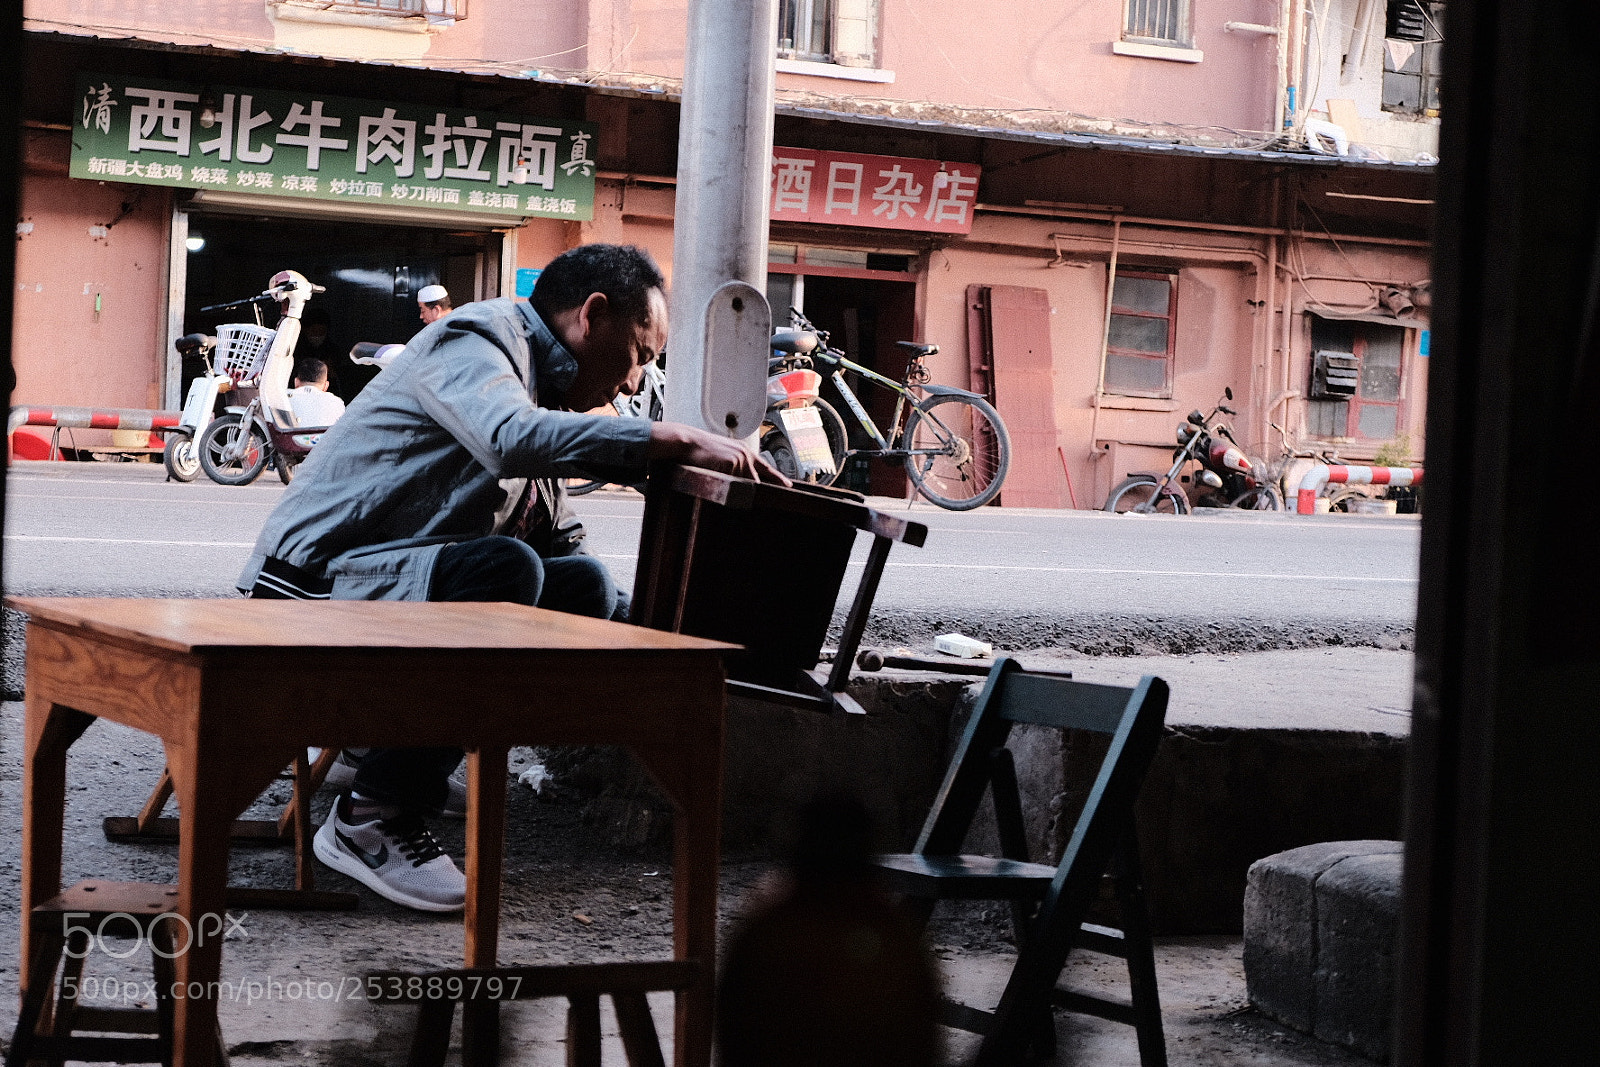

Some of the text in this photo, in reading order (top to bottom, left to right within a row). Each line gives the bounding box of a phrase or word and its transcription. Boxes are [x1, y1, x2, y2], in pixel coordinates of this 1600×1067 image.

[82, 82, 118, 135] 清
[124, 86, 563, 191] 西北牛肉拉面
[560, 130, 595, 177] 真
[88, 157, 183, 181] 新疆大盘鸡
[236, 170, 274, 188] 炒菜
[281, 174, 318, 192] 凉菜
[771, 154, 978, 225] 酒日杂店
